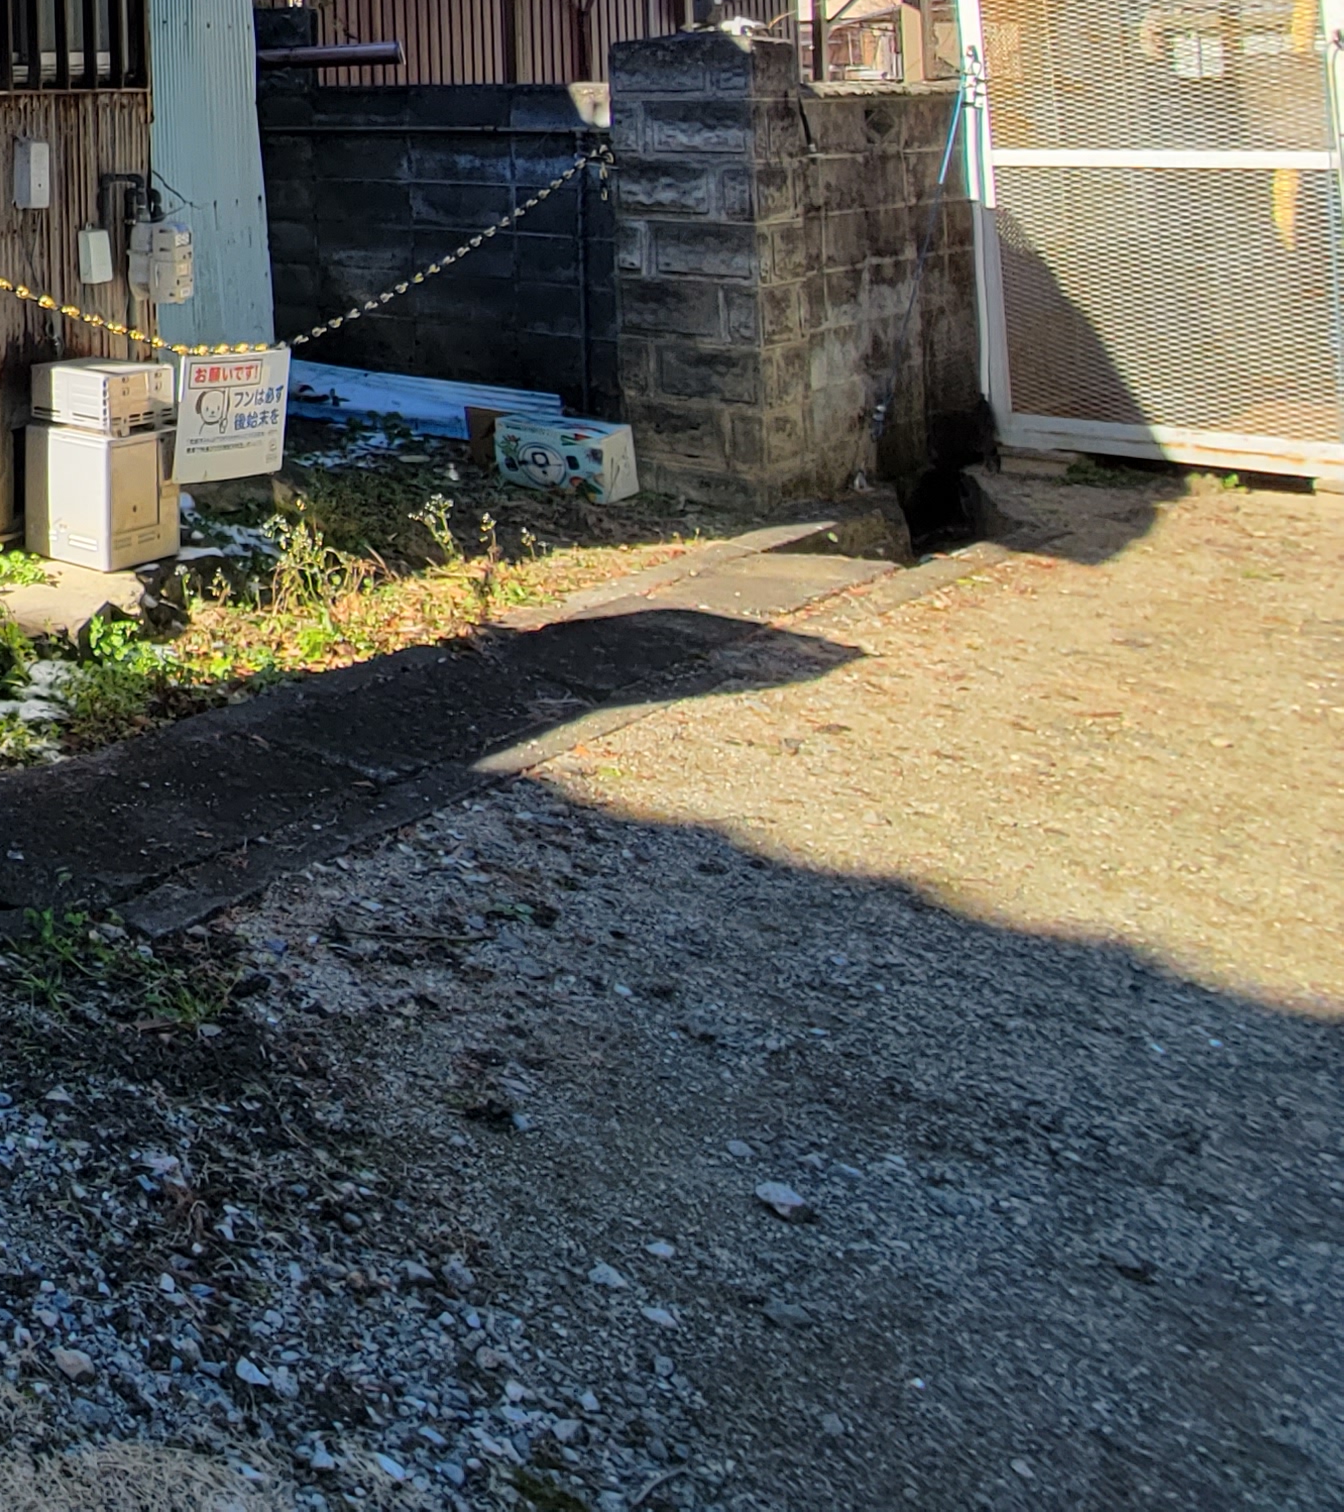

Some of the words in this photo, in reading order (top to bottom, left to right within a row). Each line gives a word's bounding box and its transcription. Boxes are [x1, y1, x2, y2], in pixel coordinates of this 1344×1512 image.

[194, 364, 259, 384] お願いです!
[233, 385, 285, 408] フンは必ず
[234, 409, 280, 431] 後始末を
